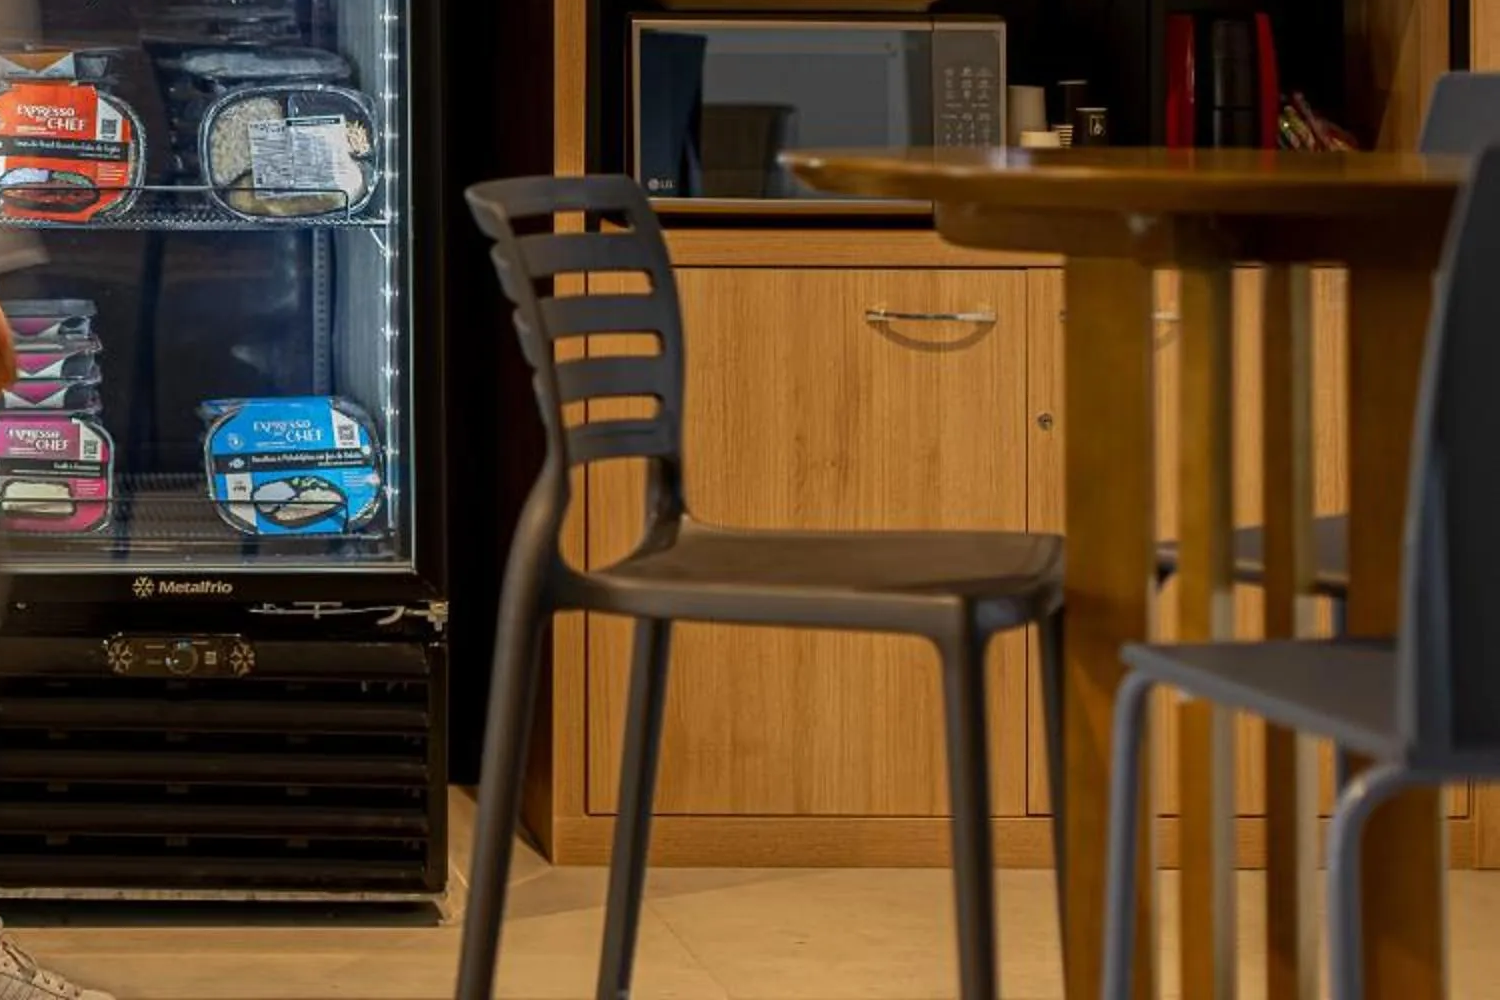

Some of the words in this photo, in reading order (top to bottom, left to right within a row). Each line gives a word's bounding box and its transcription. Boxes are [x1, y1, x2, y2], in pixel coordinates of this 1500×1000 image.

[47, 118, 87, 131] CHEF
[285, 429, 323, 442] CHEF
[35, 439, 69, 451] CHEF
[158, 580, 233, 594] Metalfrio
